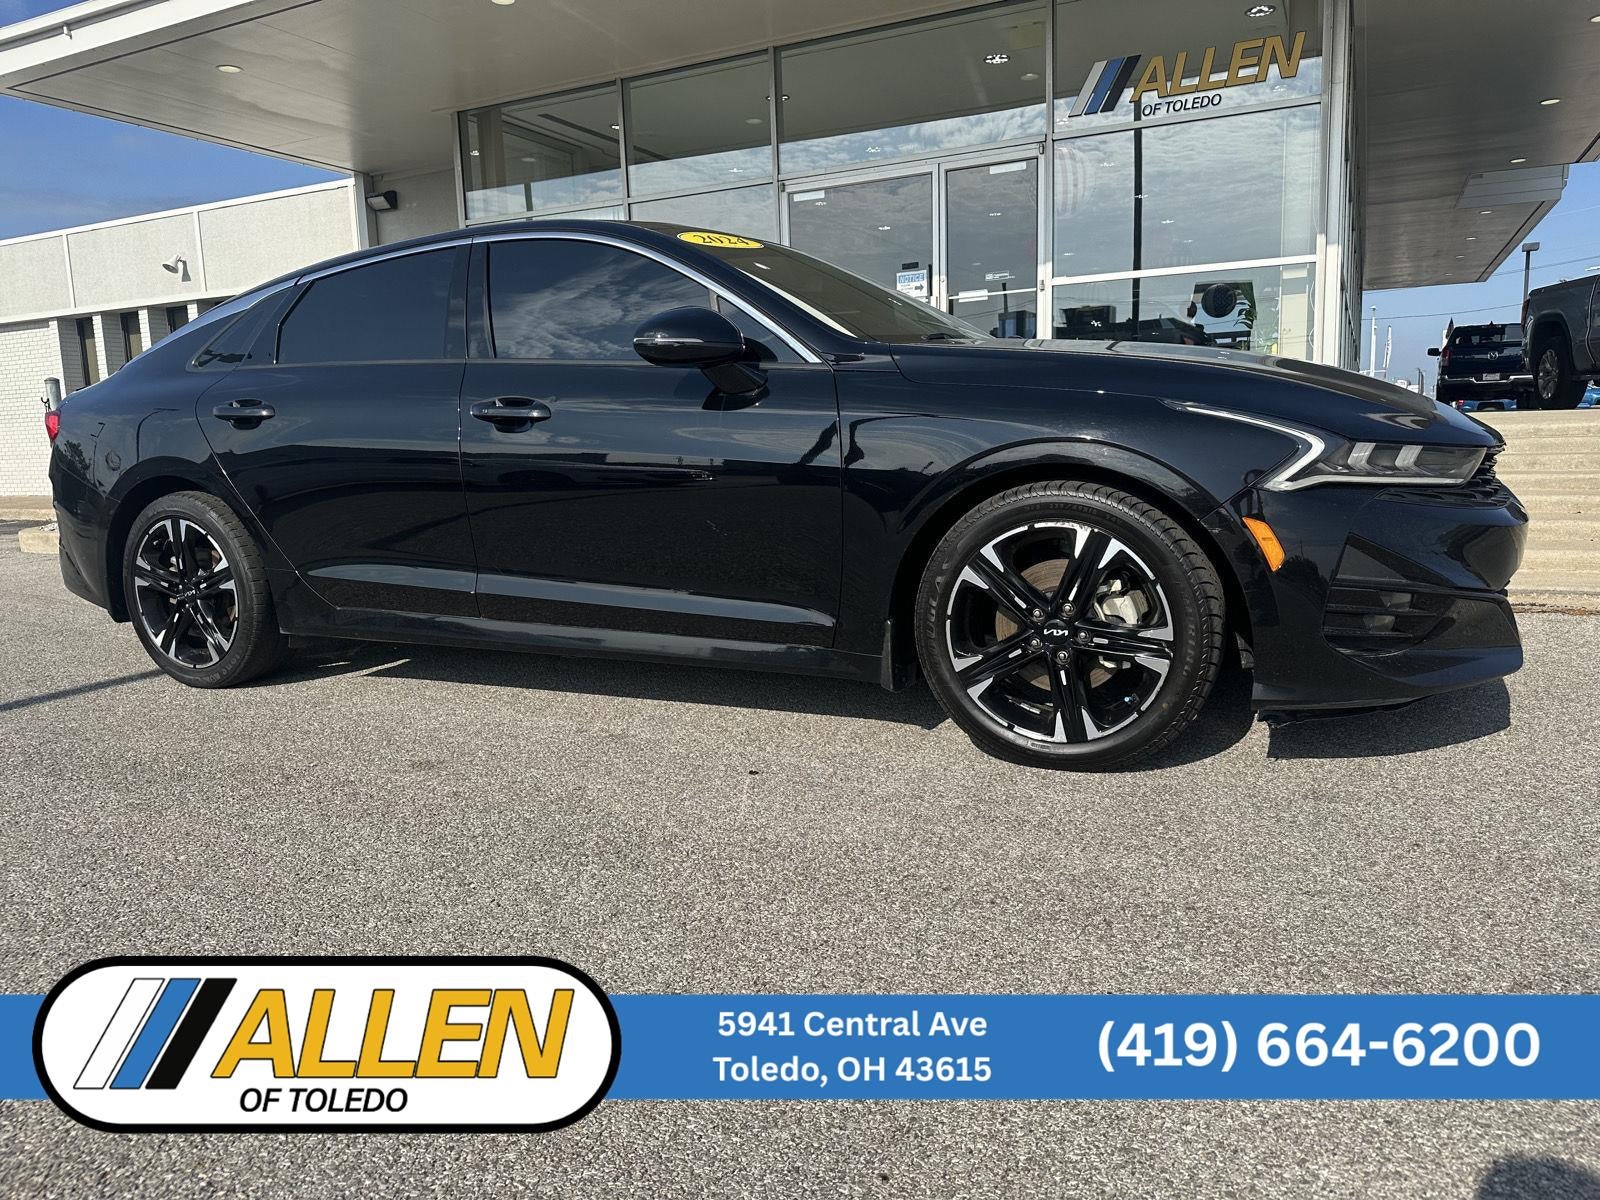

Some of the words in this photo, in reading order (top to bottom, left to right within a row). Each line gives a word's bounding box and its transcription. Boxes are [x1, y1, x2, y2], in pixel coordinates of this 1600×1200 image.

[1129, 31, 1306, 103] ALLEN
[1142, 102, 1161, 117] OF
[1164, 93, 1222, 114] TOLEDO
[693, 234, 750, 246] 2024
[899, 273, 925, 284] NOTICE
